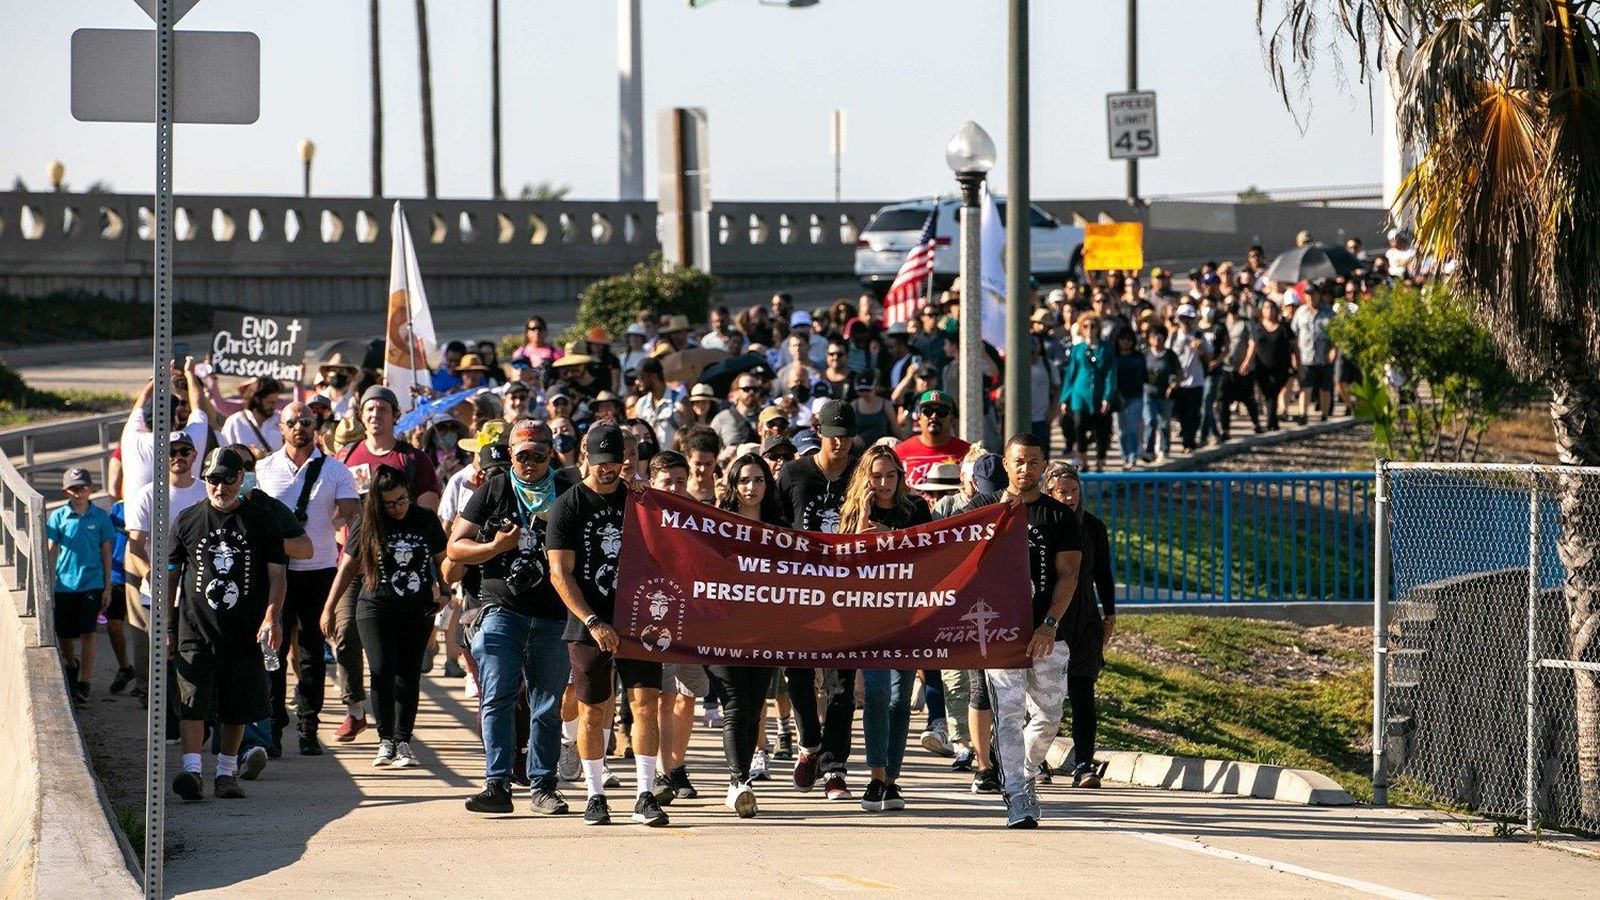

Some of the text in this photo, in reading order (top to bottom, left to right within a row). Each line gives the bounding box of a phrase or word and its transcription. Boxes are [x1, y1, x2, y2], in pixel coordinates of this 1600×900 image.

[1111, 97, 1154, 110] SPEED
[1115, 113, 1148, 126] LIMIT
[1115, 129, 1153, 151] 45
[241, 315, 278, 340] END
[213, 330, 293, 356] Christian
[212, 353, 303, 381] Persecution
[661, 509, 996, 556] MARCH FOR THE MARTYRS
[737, 555, 914, 579] WE STAND WITH
[693, 581, 957, 608] PERSECUTED CHRISTIANS
[697, 645, 949, 660] WWW.FORTHEMARTYRS.COM
